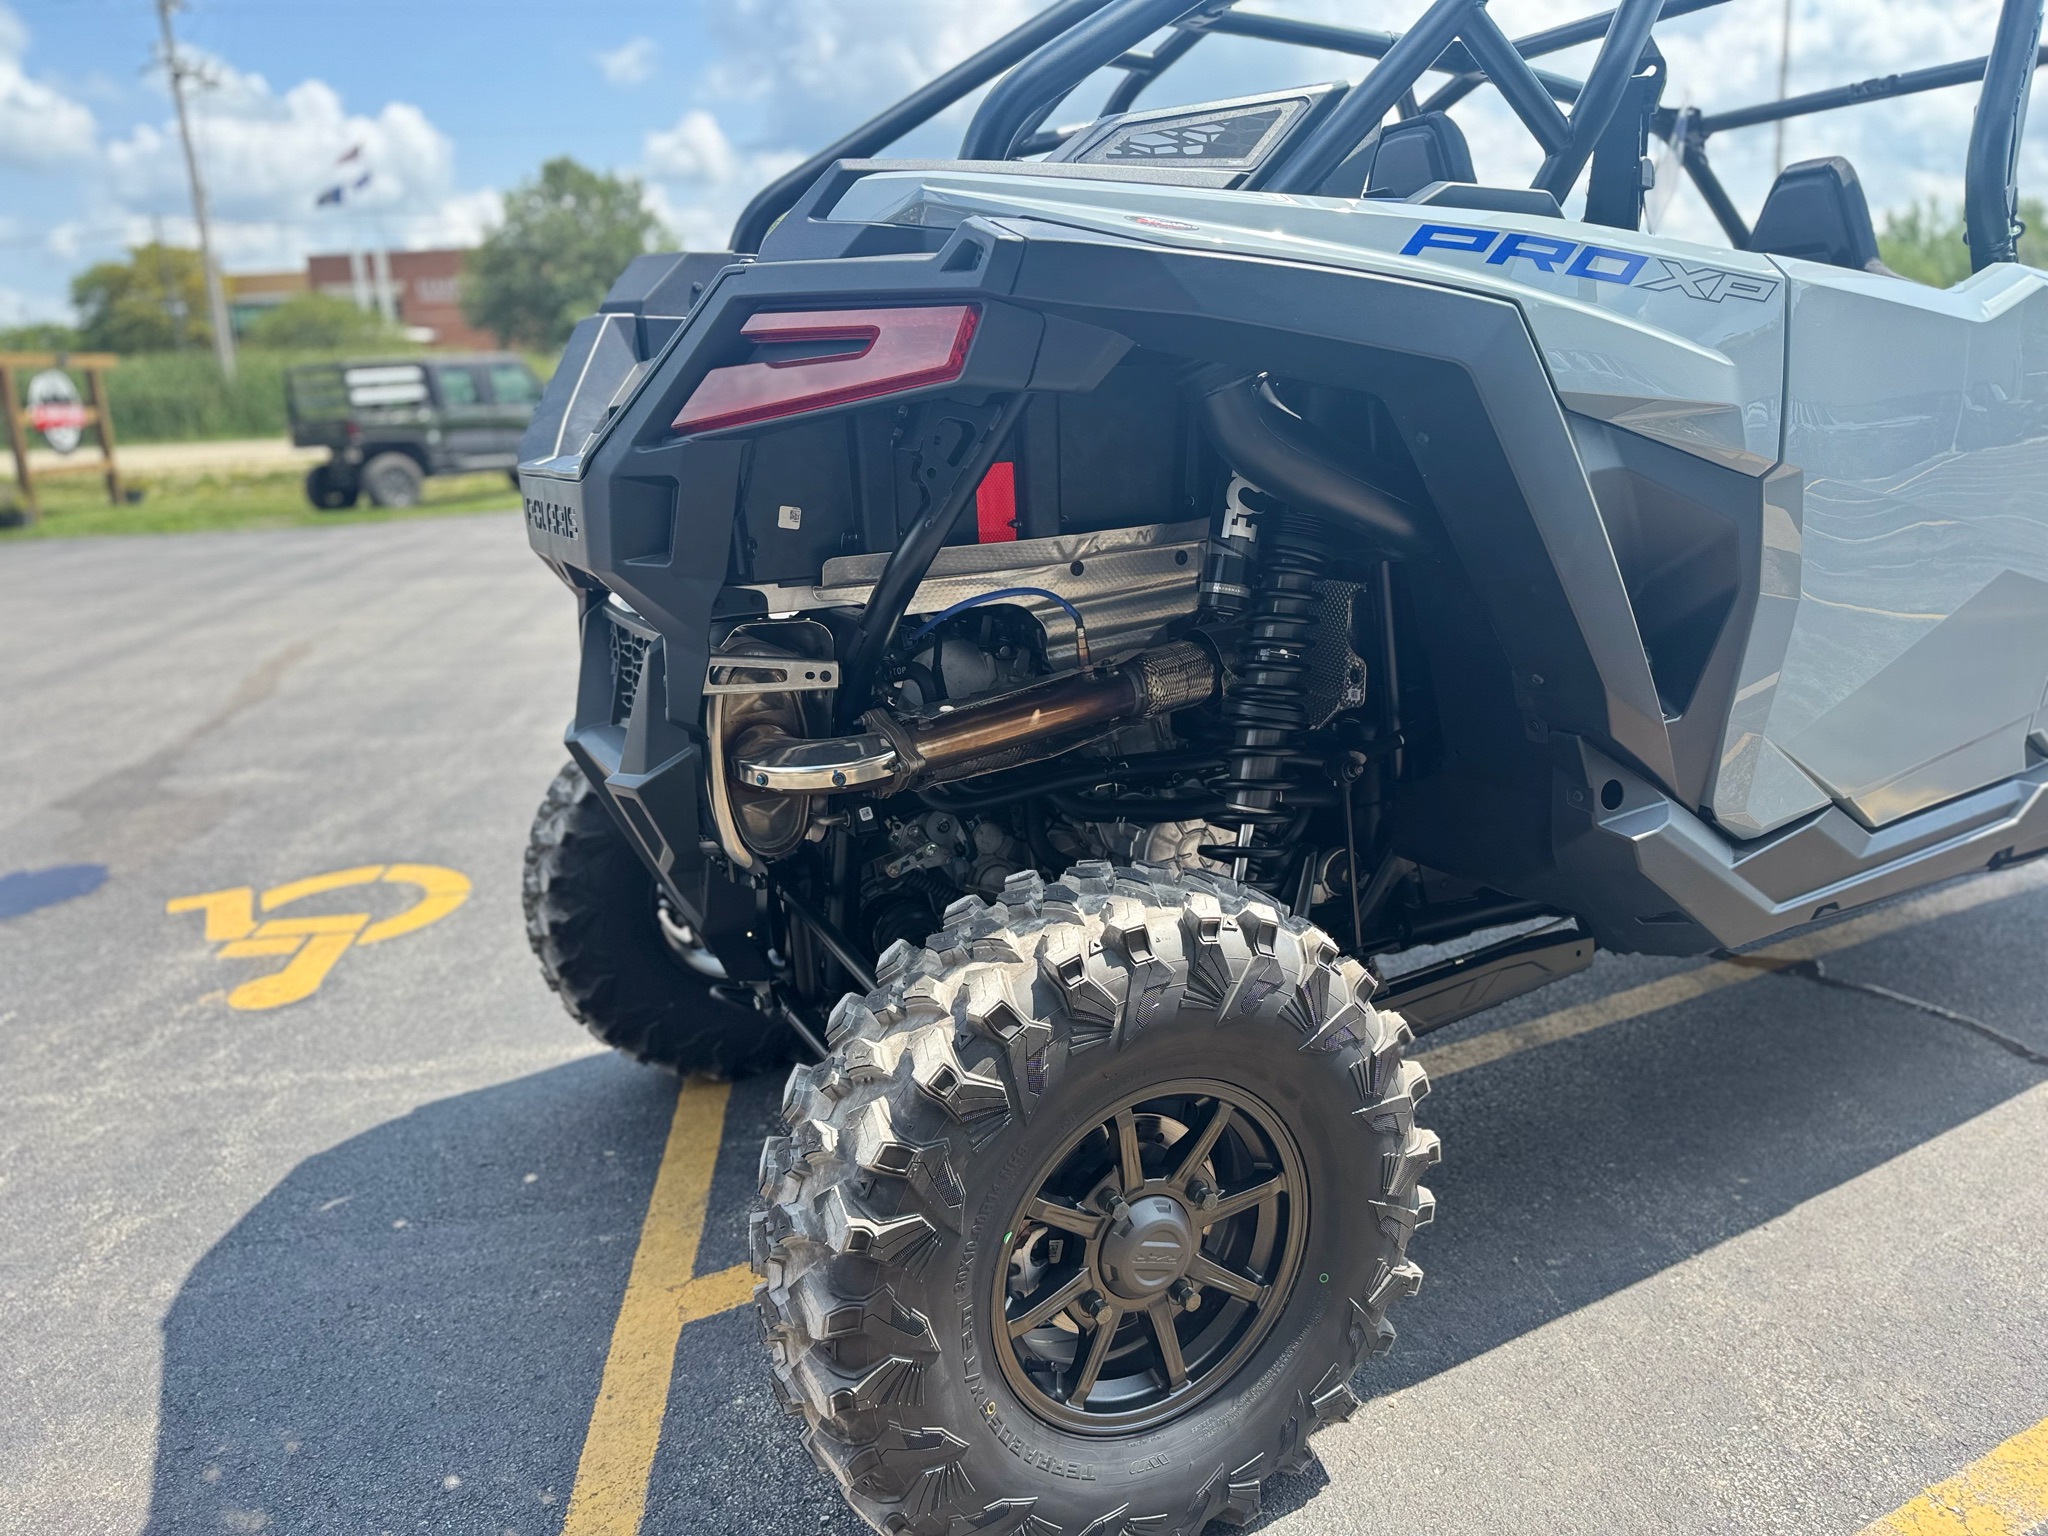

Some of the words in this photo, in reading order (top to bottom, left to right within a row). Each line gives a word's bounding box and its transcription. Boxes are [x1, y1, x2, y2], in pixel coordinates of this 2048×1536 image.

[1400, 223, 1649, 286] PRO
[1633, 257, 1782, 304] XP
[526, 498, 579, 541] POLARIS
[1221, 469, 1265, 542] FO
